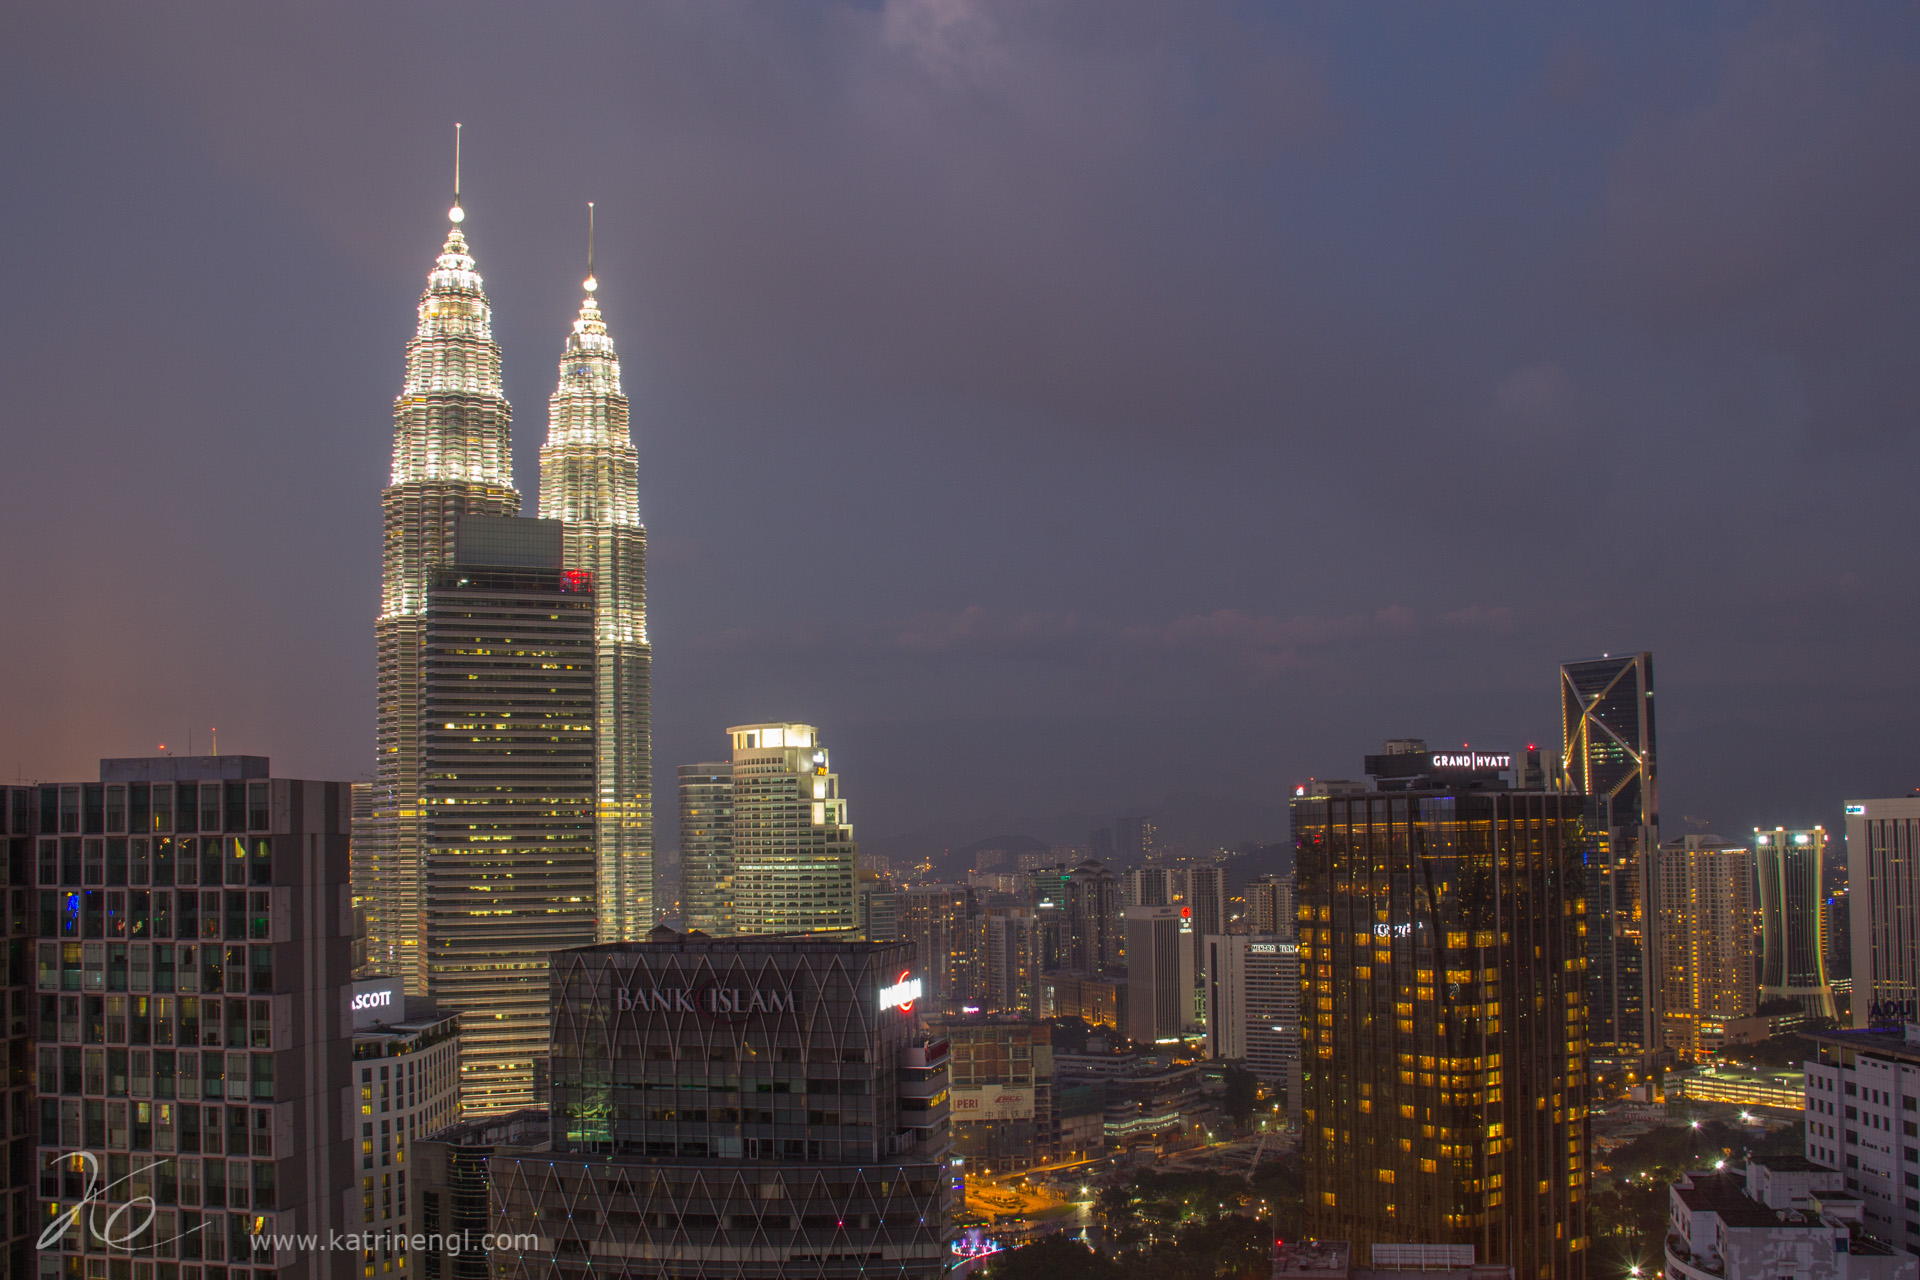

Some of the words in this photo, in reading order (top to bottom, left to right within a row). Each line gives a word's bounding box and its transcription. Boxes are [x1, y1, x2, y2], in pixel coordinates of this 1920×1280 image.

[1433, 755, 1470, 767] GRAND
[1476, 755, 1510, 767] HYATT
[617, 986, 696, 1012] BANK
[709, 987, 796, 1013] ISLAM
[957, 1098, 978, 1109] PERI
